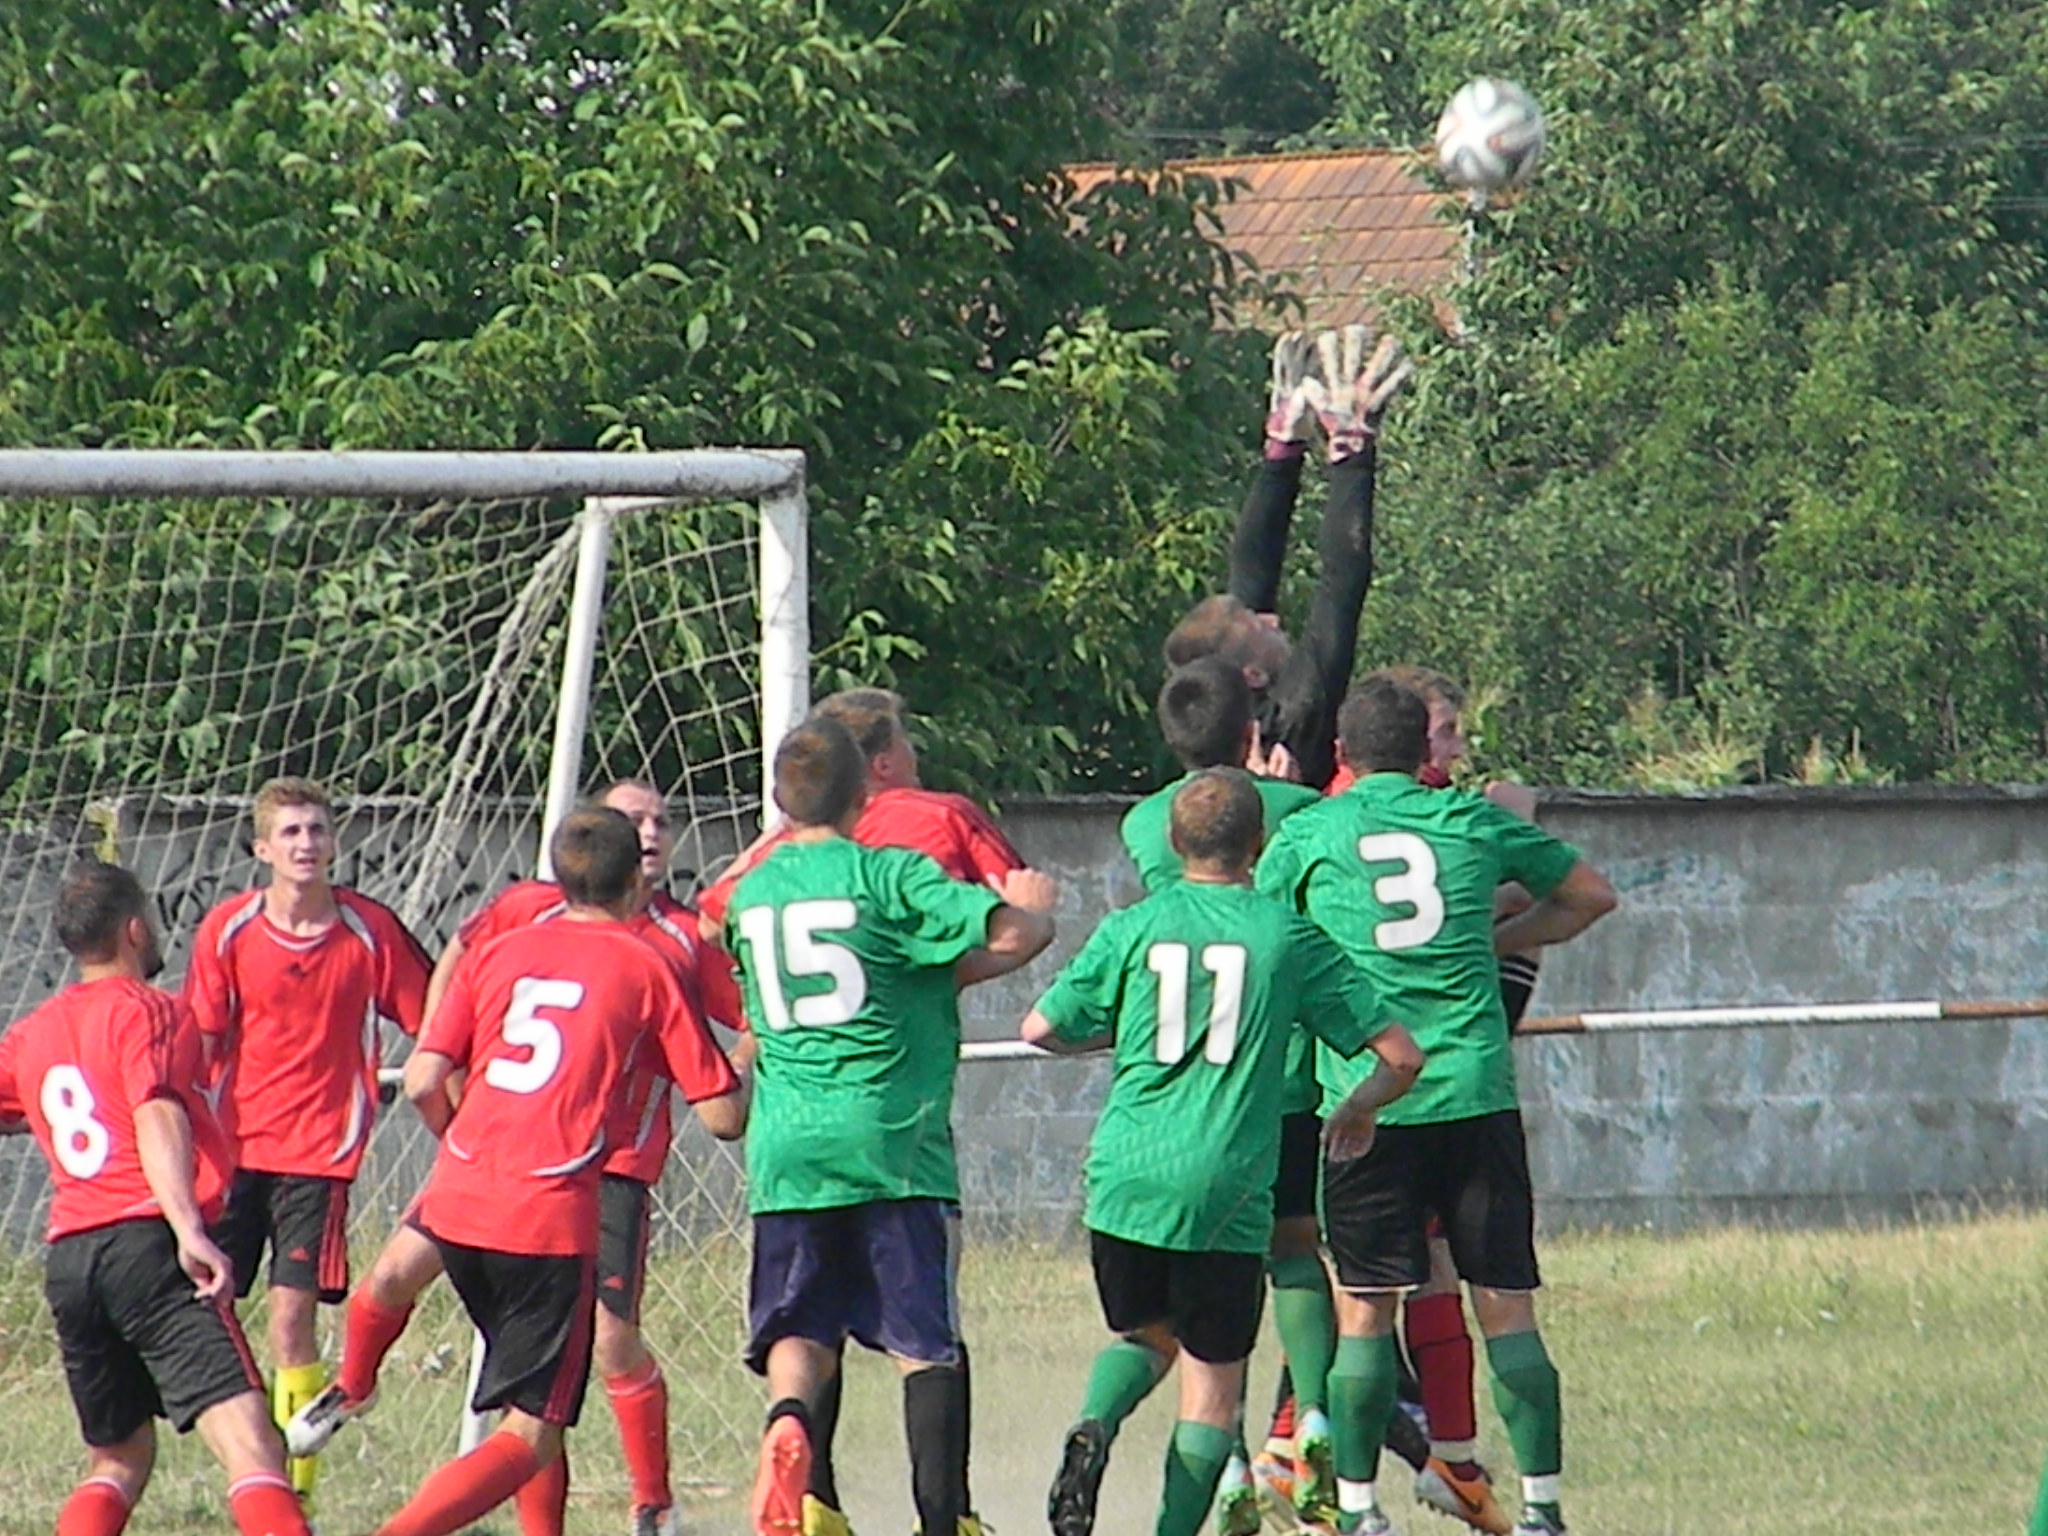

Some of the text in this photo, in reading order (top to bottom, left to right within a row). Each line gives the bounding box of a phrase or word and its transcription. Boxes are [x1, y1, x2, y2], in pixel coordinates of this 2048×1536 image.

[1357, 832, 1445, 950] 3
[738, 899, 866, 1031] 15
[1147, 942, 1246, 1065] 11
[485, 977, 583, 1094] 5
[40, 1064, 109, 1179] 8
